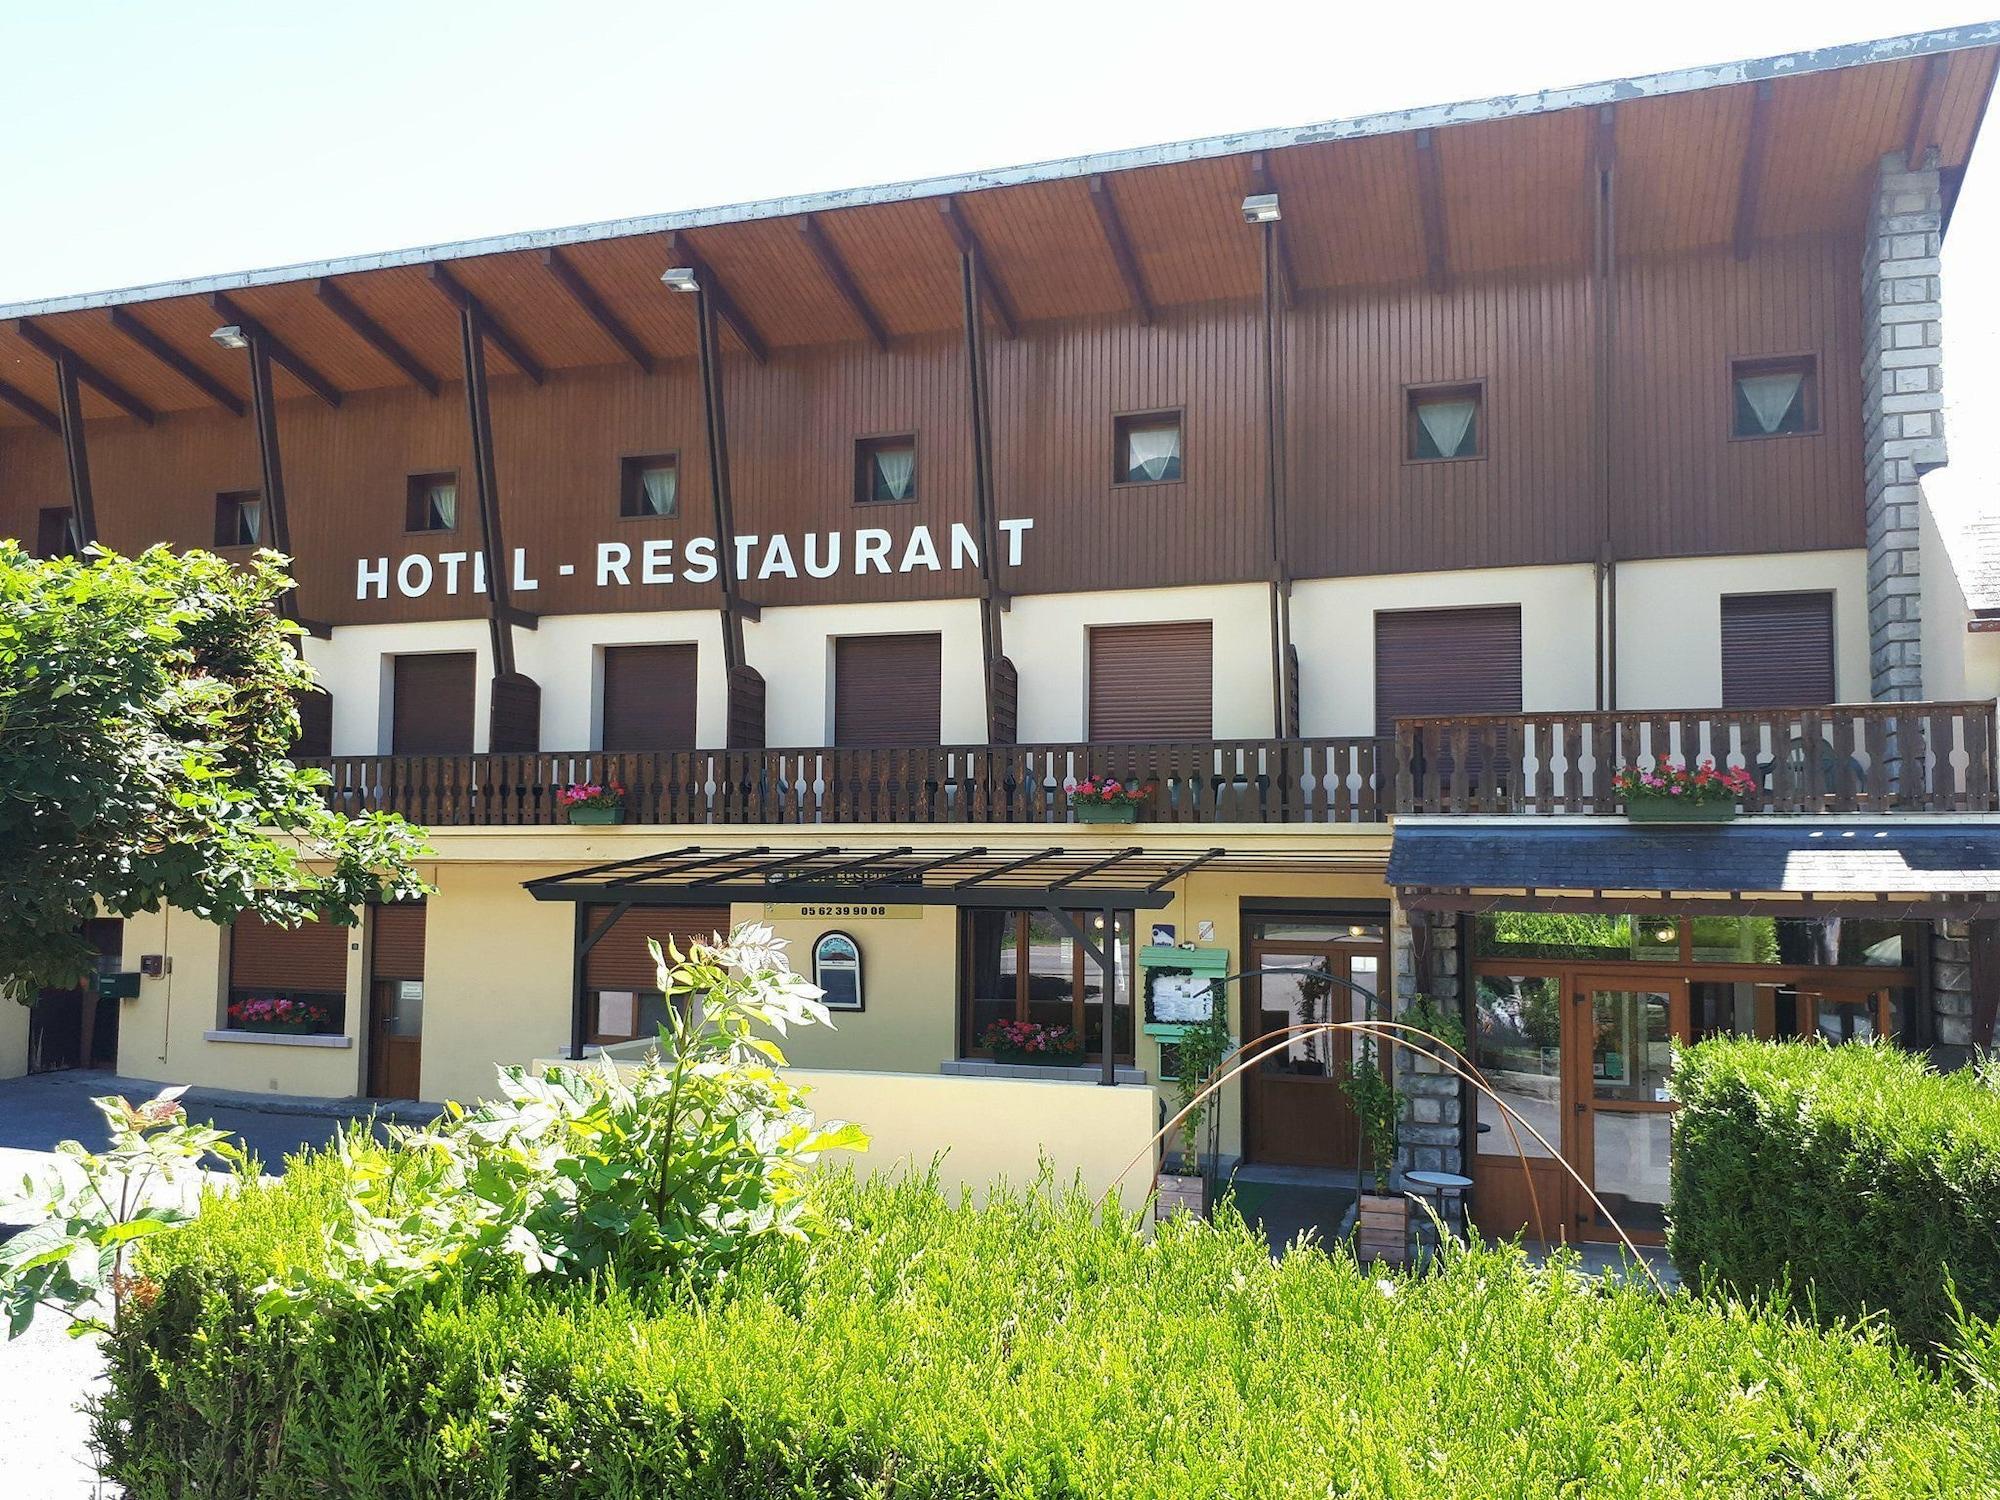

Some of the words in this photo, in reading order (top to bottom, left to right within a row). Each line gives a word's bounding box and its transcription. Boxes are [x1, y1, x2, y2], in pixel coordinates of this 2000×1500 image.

[596, 518, 1034, 587] RESTAURANT
[801, 906, 815, 915] 05
[819, 906, 832, 915] 62
[835, 906, 849, 915] 39
[853, 906, 867, 916] 90
[871, 906, 885, 915] 08
